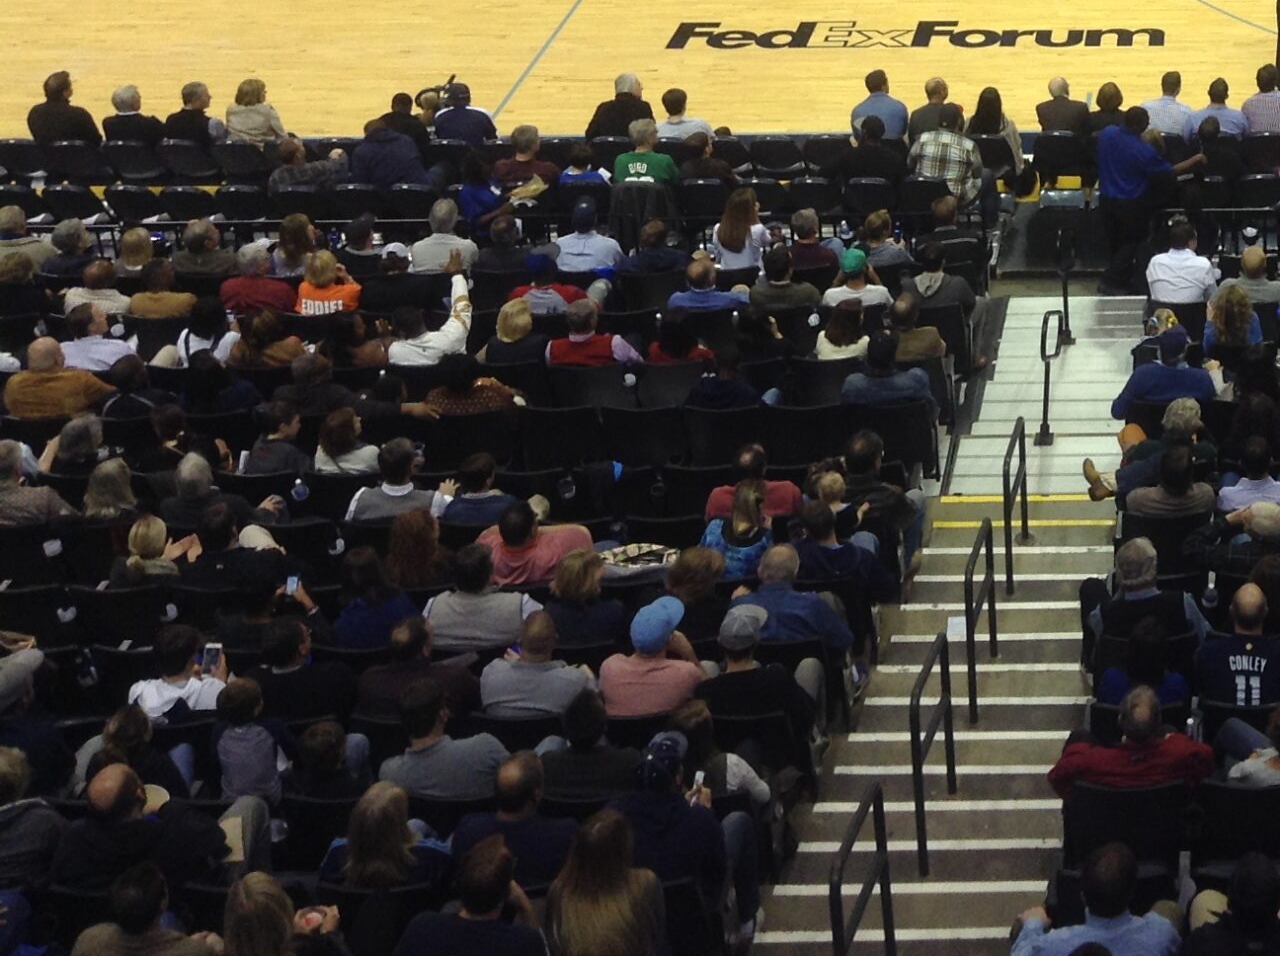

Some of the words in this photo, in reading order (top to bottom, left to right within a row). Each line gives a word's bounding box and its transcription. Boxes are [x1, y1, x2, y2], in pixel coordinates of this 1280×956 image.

[664, 20, 1166, 49] FedExForum
[1228, 654, 1268, 673] CONLEY
[1235, 675, 1261, 706] 11
